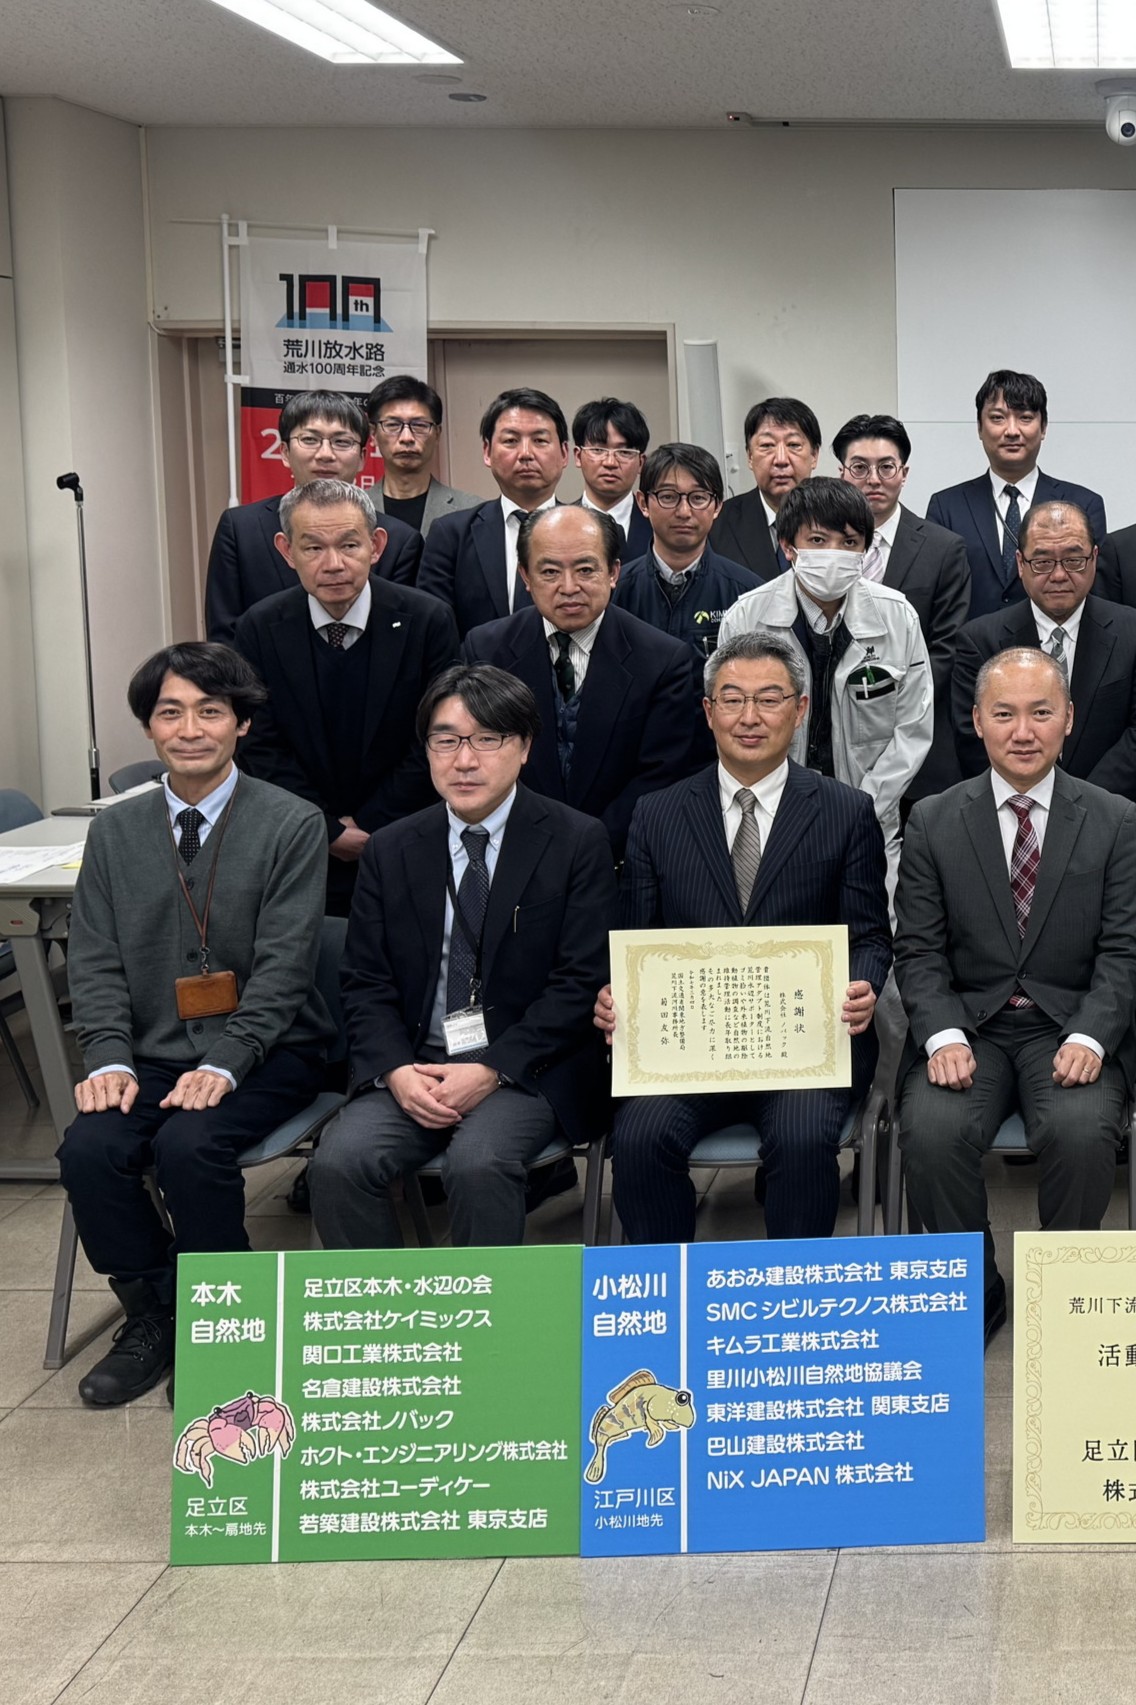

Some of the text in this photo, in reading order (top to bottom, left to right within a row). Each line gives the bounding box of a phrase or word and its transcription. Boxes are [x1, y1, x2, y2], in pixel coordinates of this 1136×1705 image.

[283, 339, 385, 362] 荒川放水路
[283, 361, 385, 378] 通水100周年記念
[699, 968, 707, 1031] 感謝の意を表します
[793, 989, 805, 1034] 感謝状
[732, 968, 740, 1059] 動植物の調査など自然地の
[747, 967, 755, 1059] 荒川水辺サポーターとして
[755, 967, 763, 1059] 管理アダプト制度における
[592, 1273, 667, 1300] 小松川
[707, 1258, 968, 1289] あおみ建設株式会社 東京支店
[191, 1282, 242, 1307] 本木
[304, 1275, 493, 1299] 足立区本木・水辺の会
[706, 1291, 968, 1321] SMC シビルテクノス株式会社
[190, 1318, 266, 1344] 自然地
[303, 1309, 493, 1332] 株式会社ケイミックス
[593, 1312, 667, 1337] 自然地
[303, 1342, 462, 1366] 関口工業株式会社
[706, 1329, 880, 1355] キムラ工業株式会社
[302, 1376, 462, 1399] 名倉建設株式会社
[707, 1360, 923, 1389] 里川小松川自然地協議会
[707, 1393, 950, 1422] 東洋建設株式会社 関東支店
[301, 1410, 454, 1432] 株式会社ノバック
[300, 1440, 568, 1466] ホクト・エンジニアリング株式会社
[707, 1431, 865, 1456] 巴山建設株式会社
[300, 1477, 491, 1501] 株式会社ユーディケー
[707, 1462, 914, 1490] NiX JAPAN 株式会社
[185, 1497, 249, 1518] 足立区
[594, 1487, 676, 1509] 江戸川区
[299, 1508, 548, 1535] 若築建設株式会社 東京支店
[594, 1513, 663, 1530] 小松川地先
